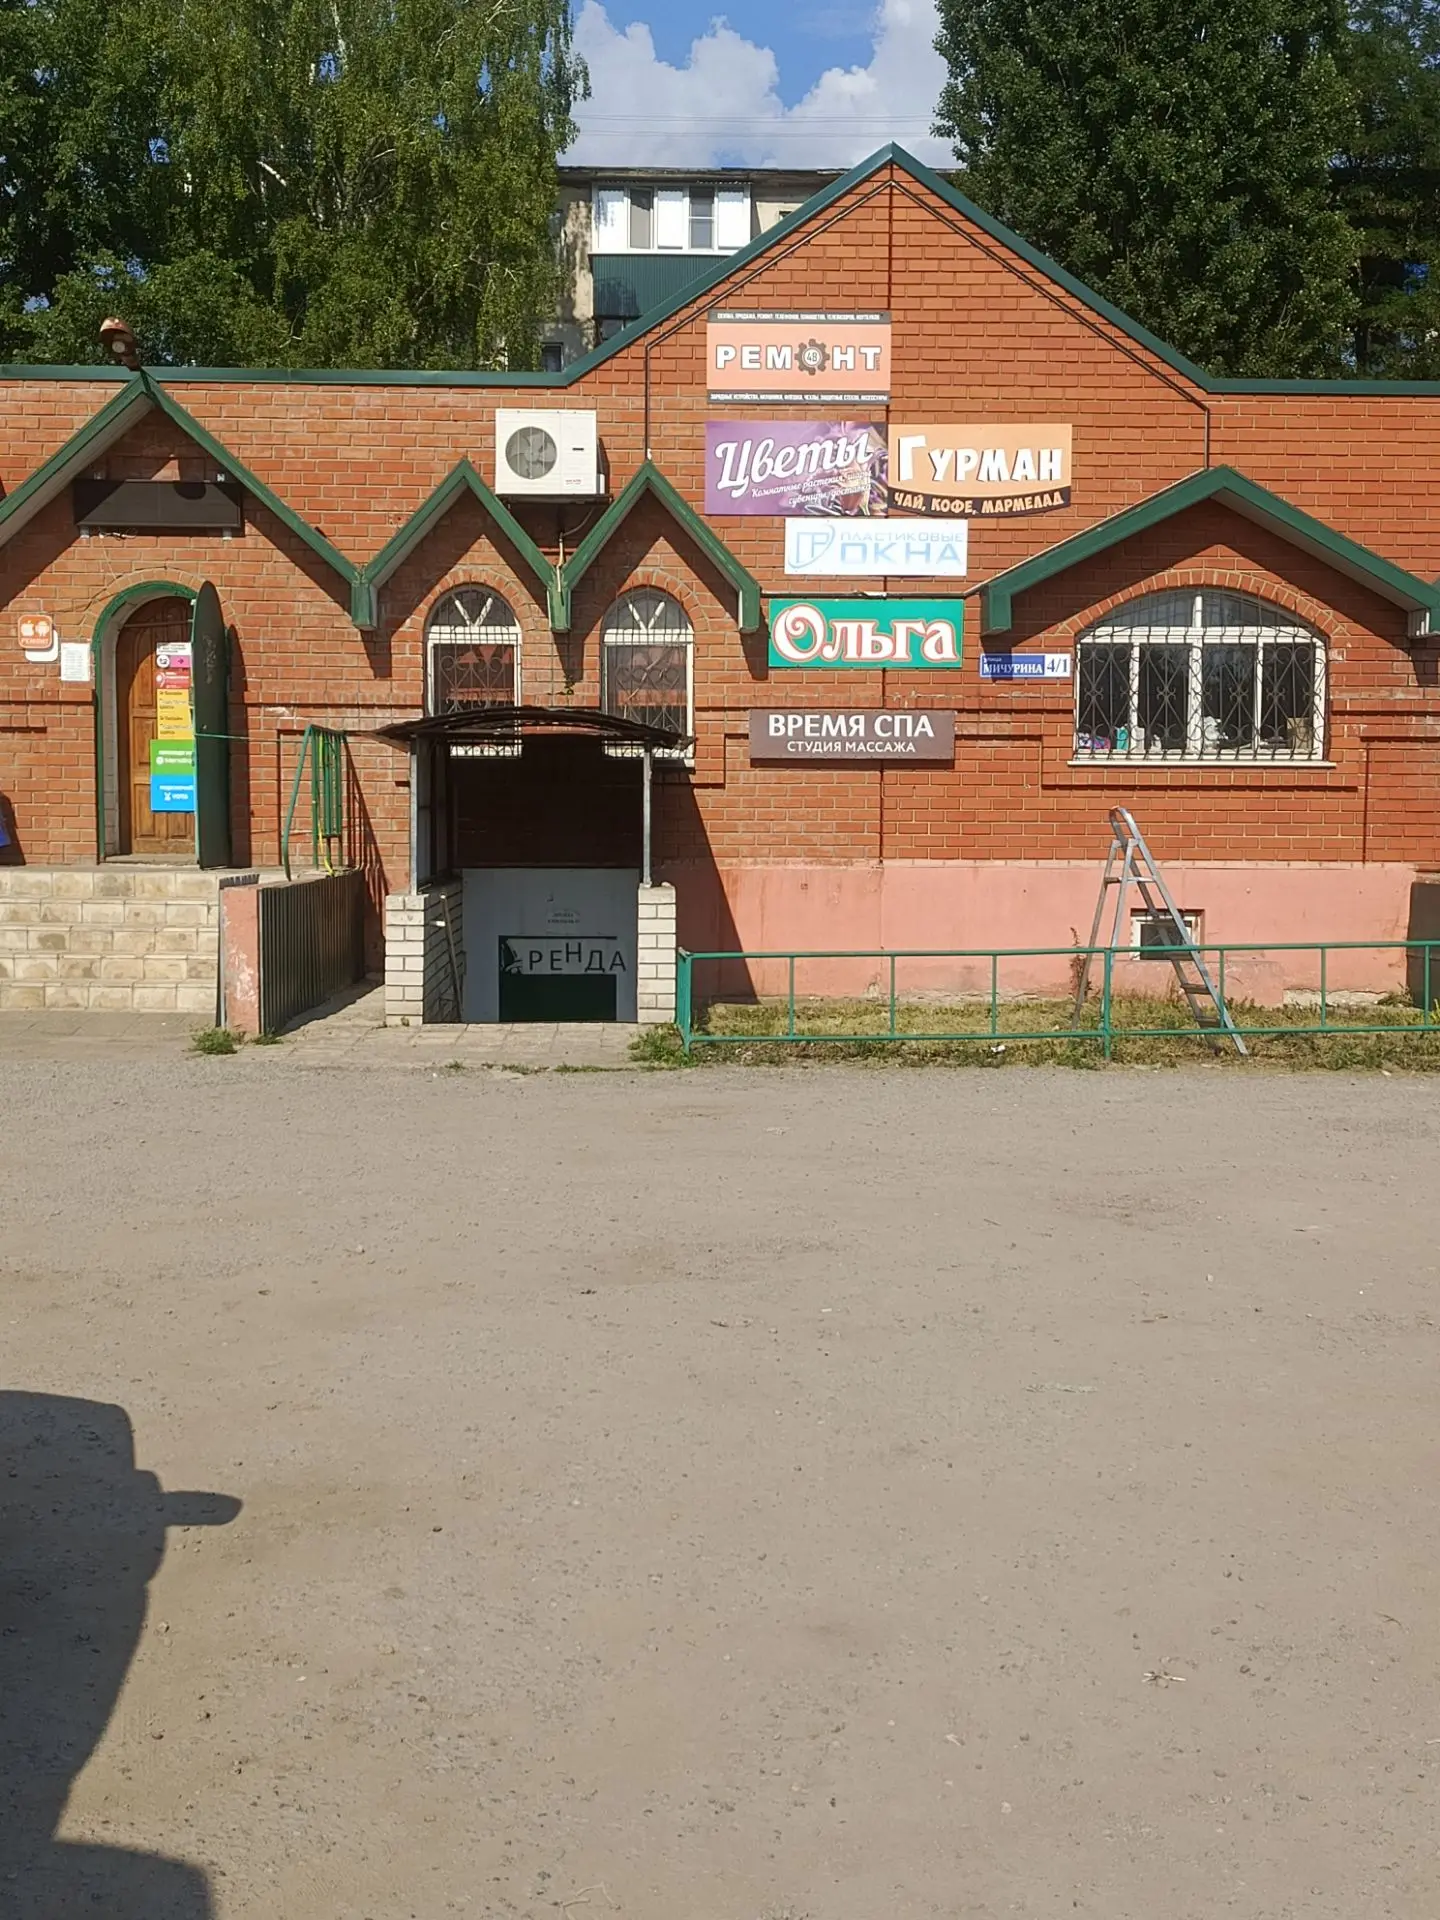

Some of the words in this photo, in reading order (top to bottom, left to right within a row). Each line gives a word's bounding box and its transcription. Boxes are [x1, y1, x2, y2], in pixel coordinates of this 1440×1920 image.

[715, 432, 875, 498] Цветы
[751, 484, 802, 498] Комнатные
[893, 491, 926, 511] ЧАЙ,
[931, 498, 978, 515] КОФЕ,
[981, 492, 1064, 514] МАРМЕЛАД
[840, 532, 965, 542] ПЛАСТИКОВЫЕ
[840, 542, 963, 565] ОКНА
[983, 664, 1043, 674] МИЧУРИНА
[1046, 658, 1069, 673] 4/1
[768, 714, 865, 737] ВРЕМЯ
[874, 714, 935, 737] СПА
[787, 741, 841, 753] СТУДИЯ
[845, 741, 916, 753] МАССАЖА
